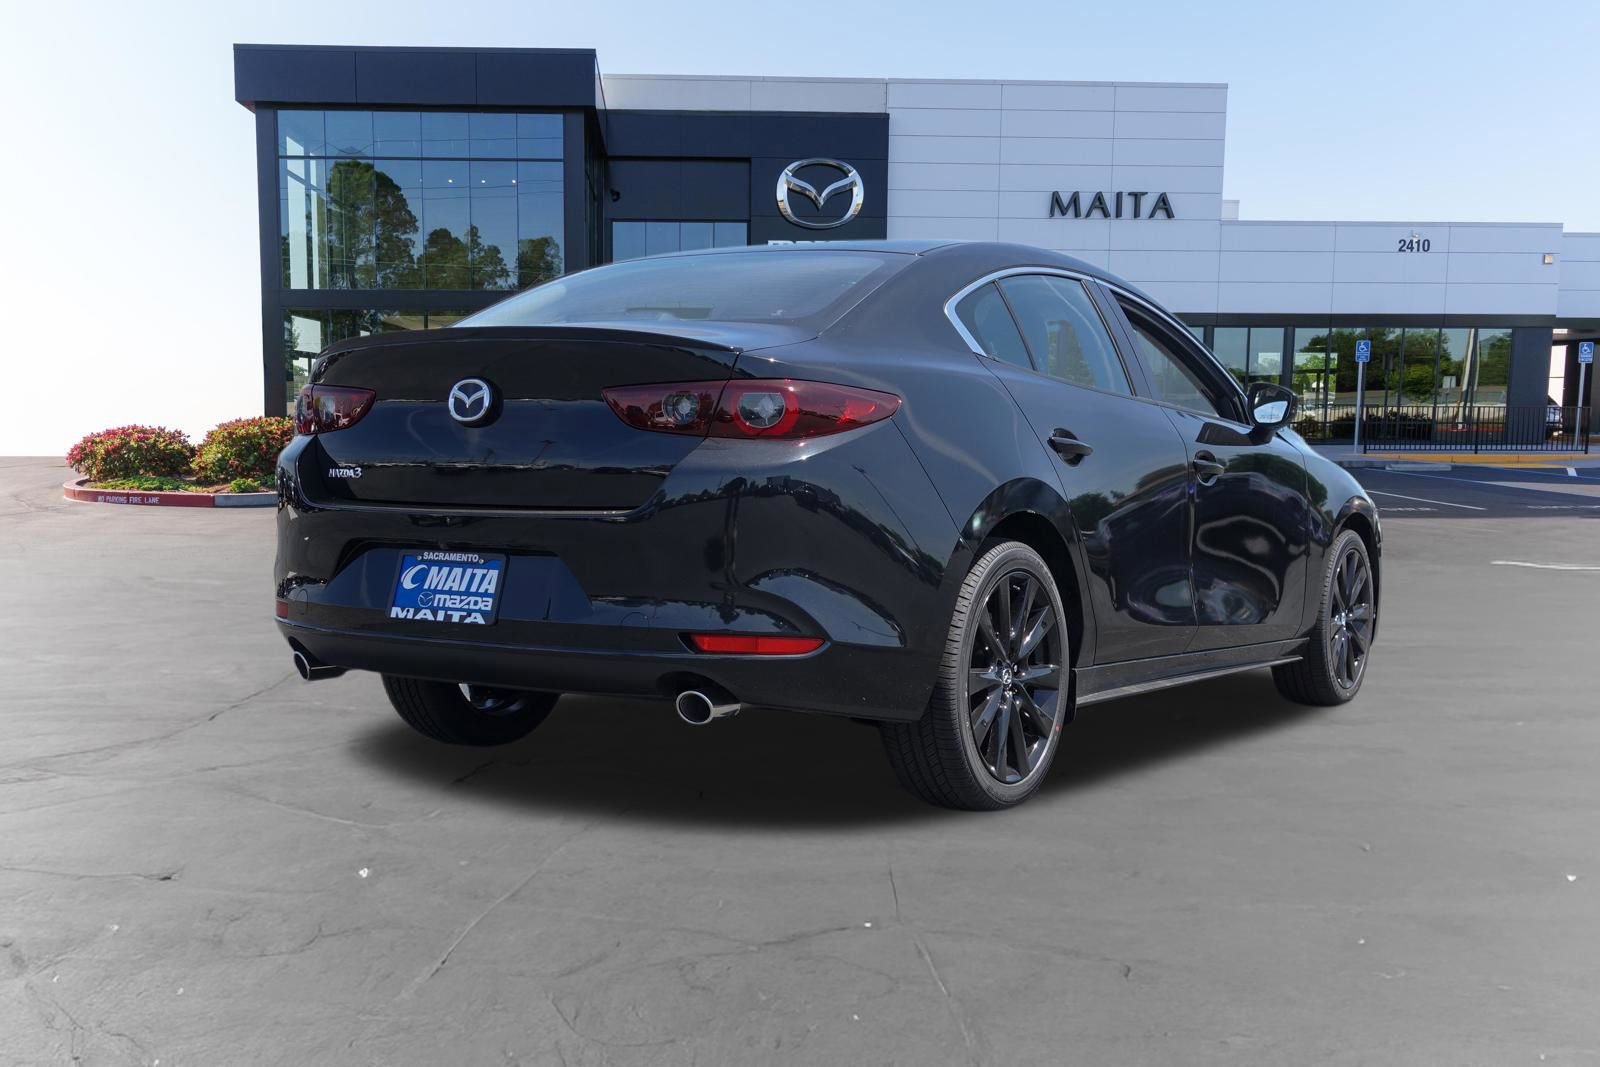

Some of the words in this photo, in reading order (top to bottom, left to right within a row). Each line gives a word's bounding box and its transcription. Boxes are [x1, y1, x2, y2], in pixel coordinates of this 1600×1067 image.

[1049, 190, 1175, 219] MAITA
[1398, 239, 1430, 252] 2410
[105, 496, 127, 504] PARKING
[129, 496, 143, 504] FIRE
[144, 496, 160, 505] LANE
[423, 552, 479, 562] SACRAMENTO
[423, 566, 499, 593] MAITA
[433, 594, 493, 611] mazda
[390, 606, 486, 625] MAITA
